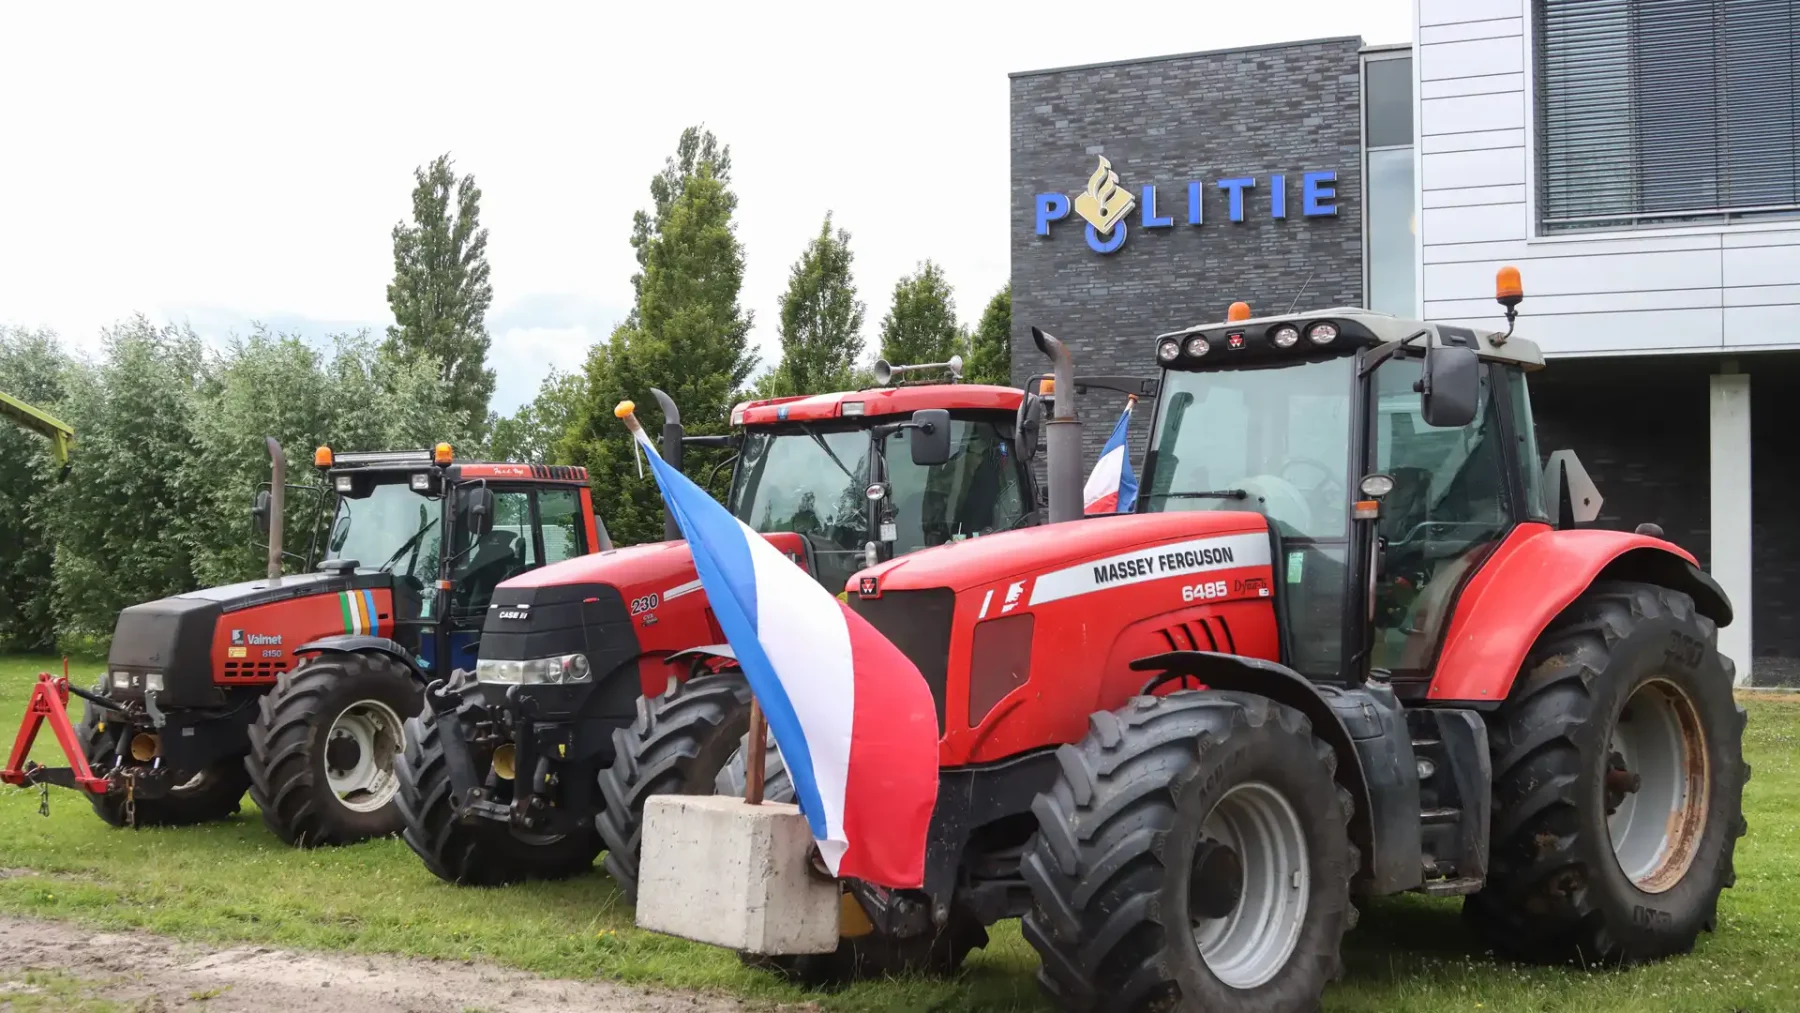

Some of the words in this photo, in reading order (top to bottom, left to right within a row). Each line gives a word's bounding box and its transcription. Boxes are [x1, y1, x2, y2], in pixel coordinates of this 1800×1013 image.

[1035, 170, 1338, 254] POLITIE
[1093, 556, 1154, 585] MASSEY
[1158, 546, 1235, 573] FERGUSON
[1181, 580, 1228, 602] 6485
[499, 611, 519, 619] CASE
[630, 592, 659, 616] 230
[247, 633, 282, 645] Valmet
[262, 649, 282, 658] 8150
